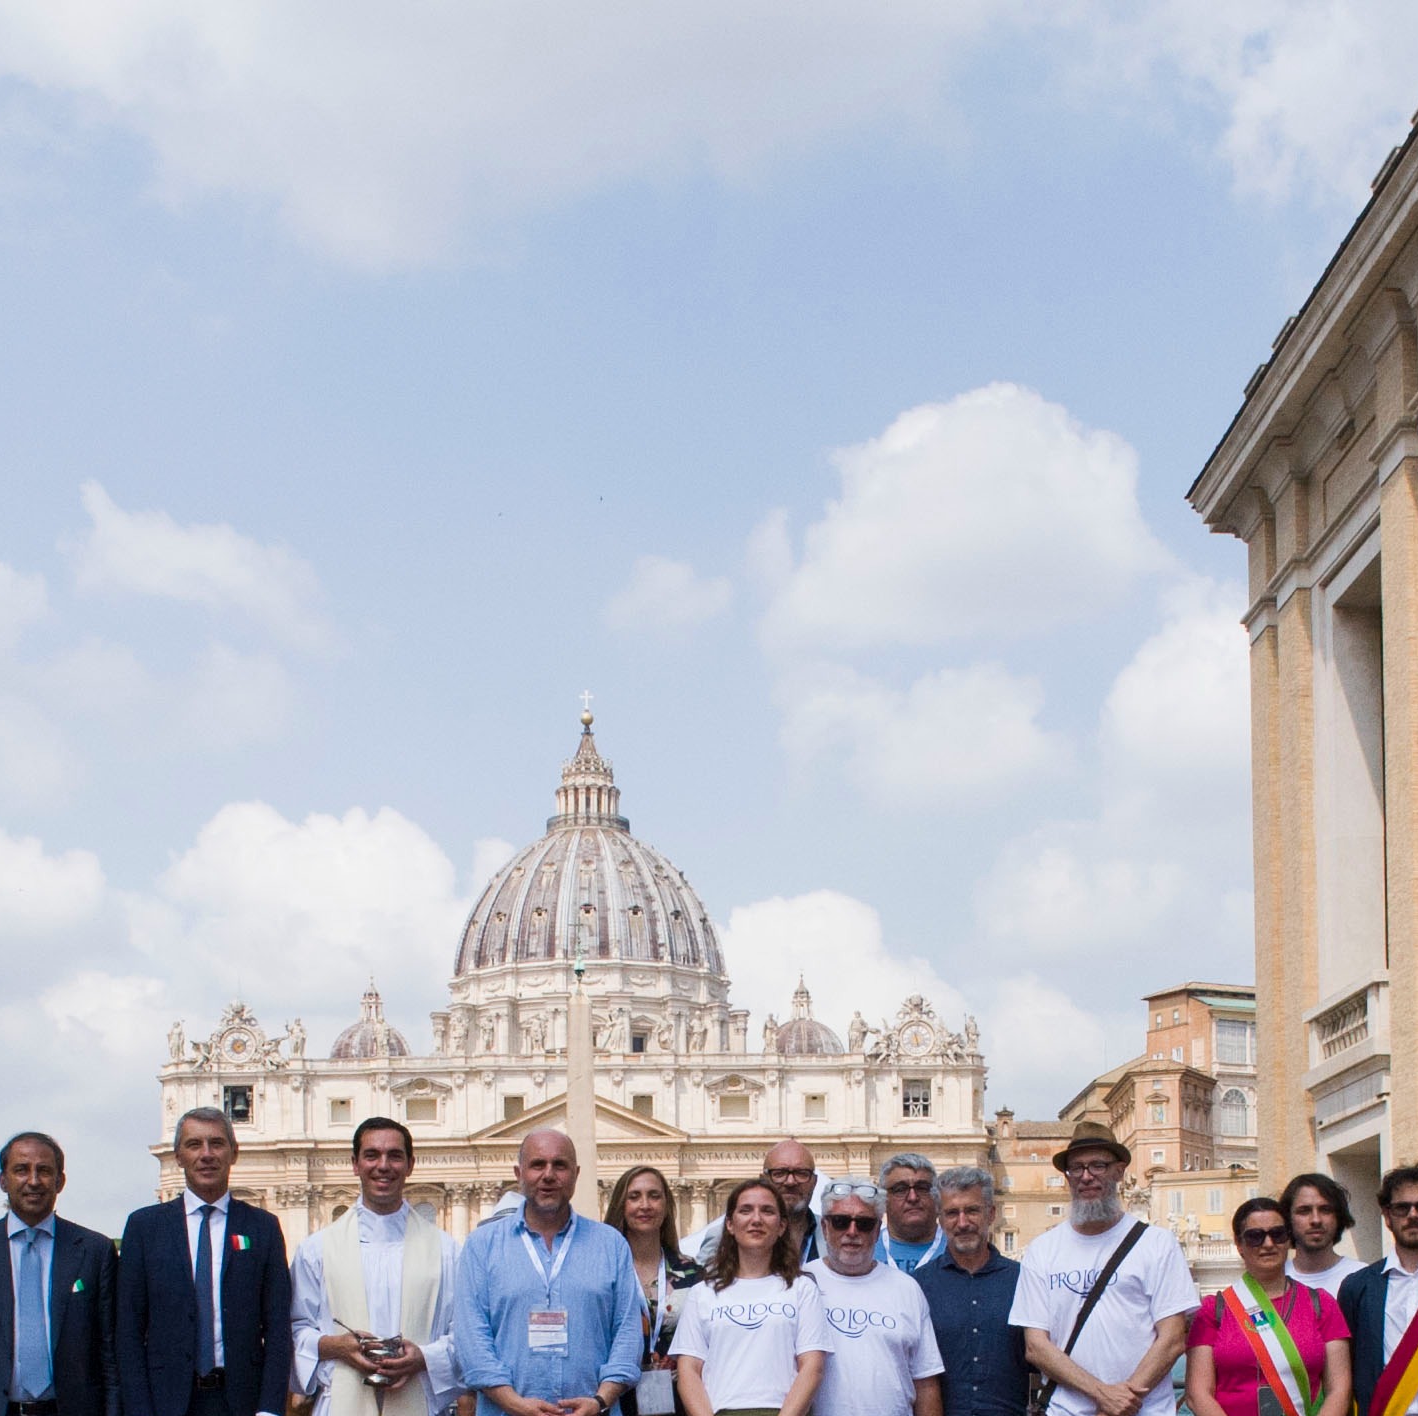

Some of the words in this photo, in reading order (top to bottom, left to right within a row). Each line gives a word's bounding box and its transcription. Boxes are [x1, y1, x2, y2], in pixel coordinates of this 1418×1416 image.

[288, 1158, 302, 1167] IN
[308, 1158, 351, 1167] HONOR
[615, 1152, 678, 1161] ROMANVS
[1050, 1270, 1081, 1290] PRO
[710, 1304, 744, 1322] PRO
[748, 1302, 796, 1321] LOCO
[848, 1308, 896, 1330] LOCO
